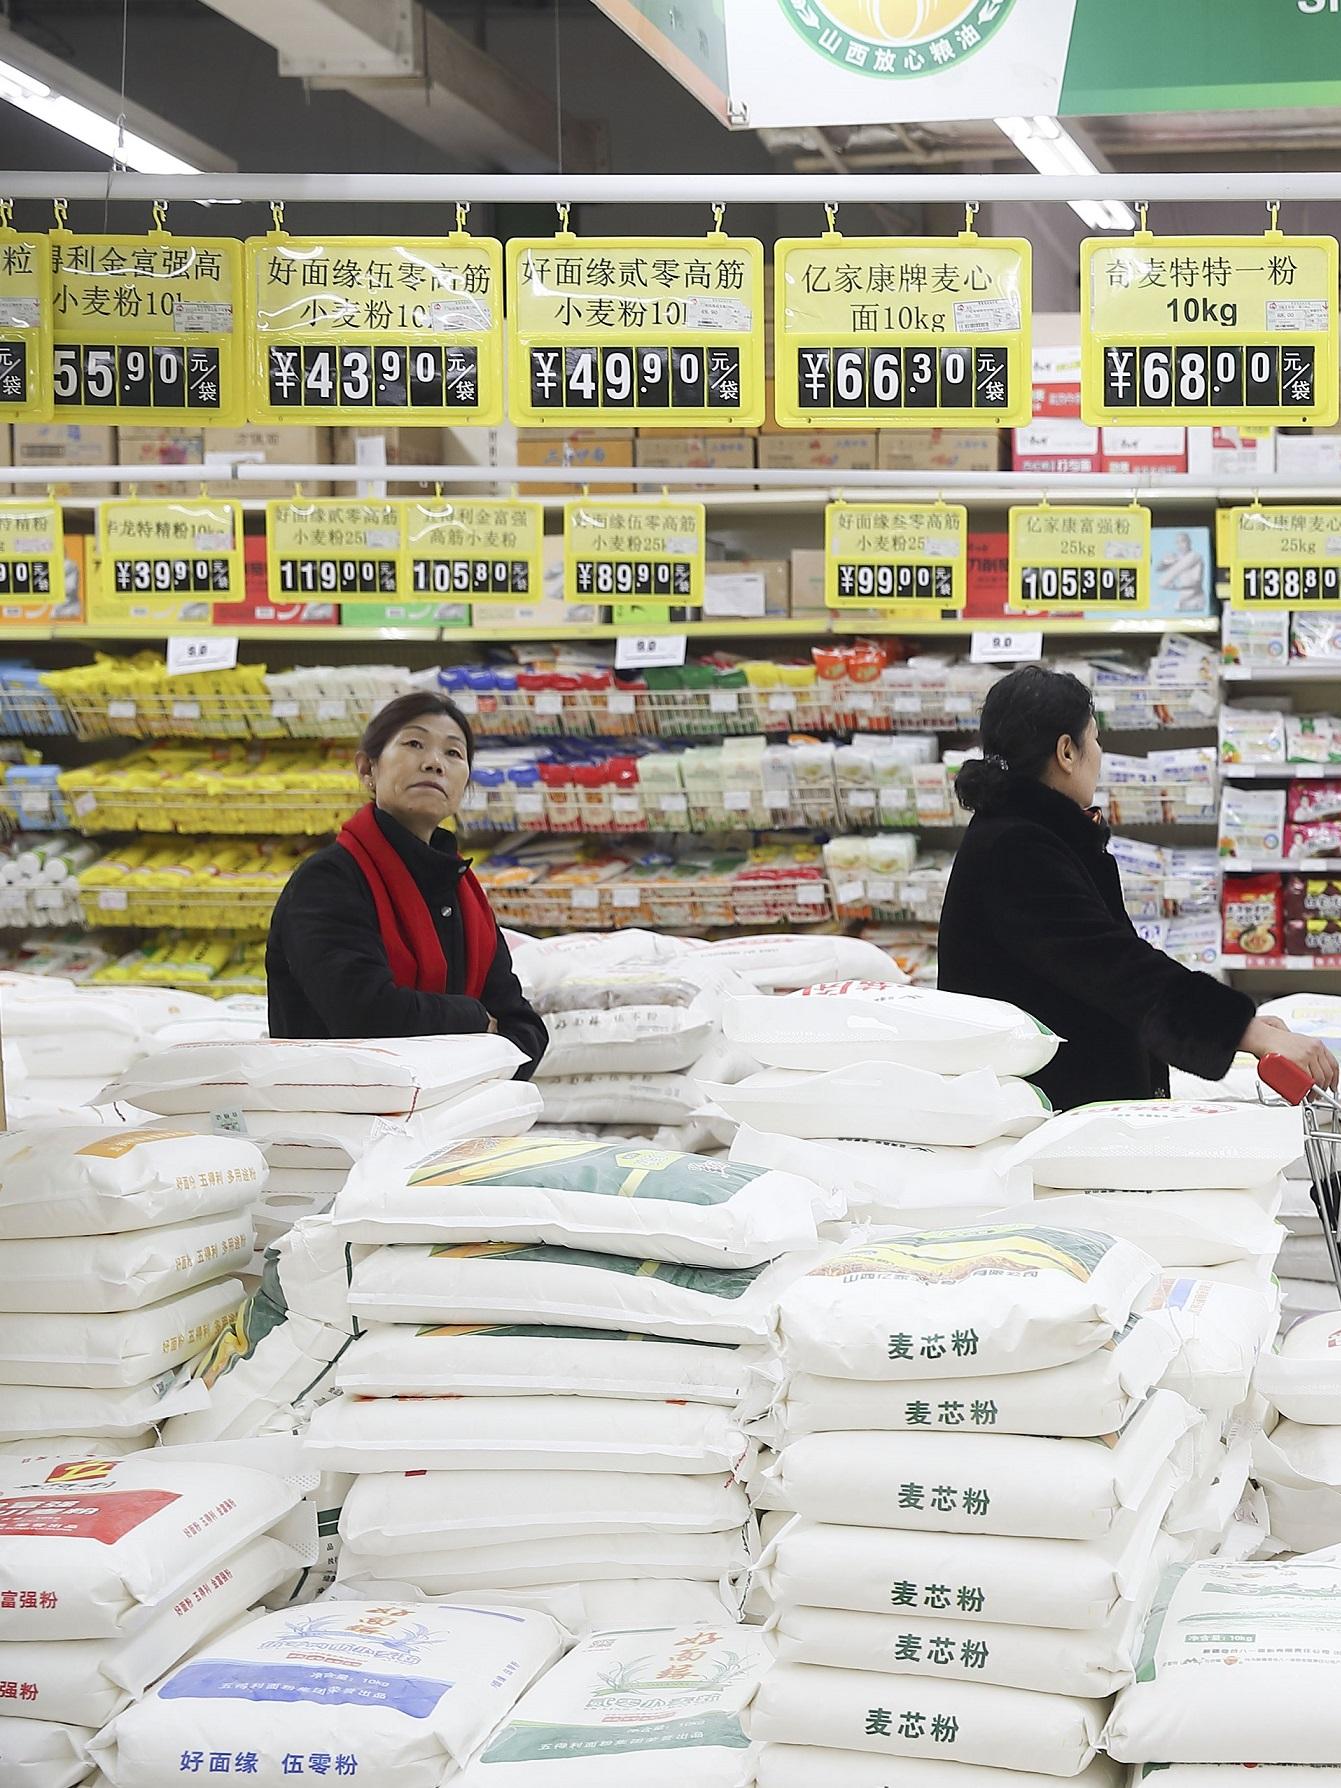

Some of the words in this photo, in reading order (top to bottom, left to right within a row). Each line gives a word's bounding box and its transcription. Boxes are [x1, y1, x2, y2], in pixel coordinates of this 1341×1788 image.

[818, 24, 981, 73] 山西放心粮油
[3, 247, 33, 276] 粒
[267, 255, 491, 295] 好面缘伍零高筋
[522, 257, 744, 290] 好面缘贰零高筋
[1105, 255, 1298, 288] 奇麦特特一粉
[801, 263, 992, 294] 亿家康牌麦心
[53, 284, 183, 318] 小麦粉10
[300, 299, 432, 330] 小麦粉10
[554, 297, 687, 328] 小麦粉10
[1166, 297, 1238, 327] 10kg
[850, 303, 946, 333] 面10kg
[54, 350, 178, 398] 55.90
[271, 351, 435, 399] ¥43.90
[532, 352, 699, 400] ¥49.90
[802, 353, 965, 401] ¥66.30
[1107, 352, 1271, 400] ¥68.00
[293, 529, 368, 546] 小麦粉25
[593, 535, 667, 552] 小麦粉25
[857, 535, 926, 552] 小麦粉25
[1060, 540, 1097, 558] 25kg
[1280, 538, 1317, 554] 25kg
[116, 562, 208, 590] ¥39.90
[281, 561, 374, 590] 119.00
[413, 562, 507, 592] 105.80
[578, 563, 671, 593] ¥89.90
[840, 566, 931, 595] ¥99.00
[1024, 569, 1115, 600] 105.30
[1245, 569, 1337, 598] 138.80
[887, 1327, 980, 1361] 麦芯粉
[904, 1398, 999, 1427] 麦芯粉
[898, 1481, 991, 1517] 麦芯粉
[1, 1590, 58, 1610] 富强粉
[890, 1579, 986, 1613] 麦芯粉
[893, 1632, 990, 1669] 麦芯粉
[864, 1706, 960, 1744] 麦芯粉
[180, 1750, 259, 1775] 好面缘
[281, 1752, 359, 1776] 伍零粉
